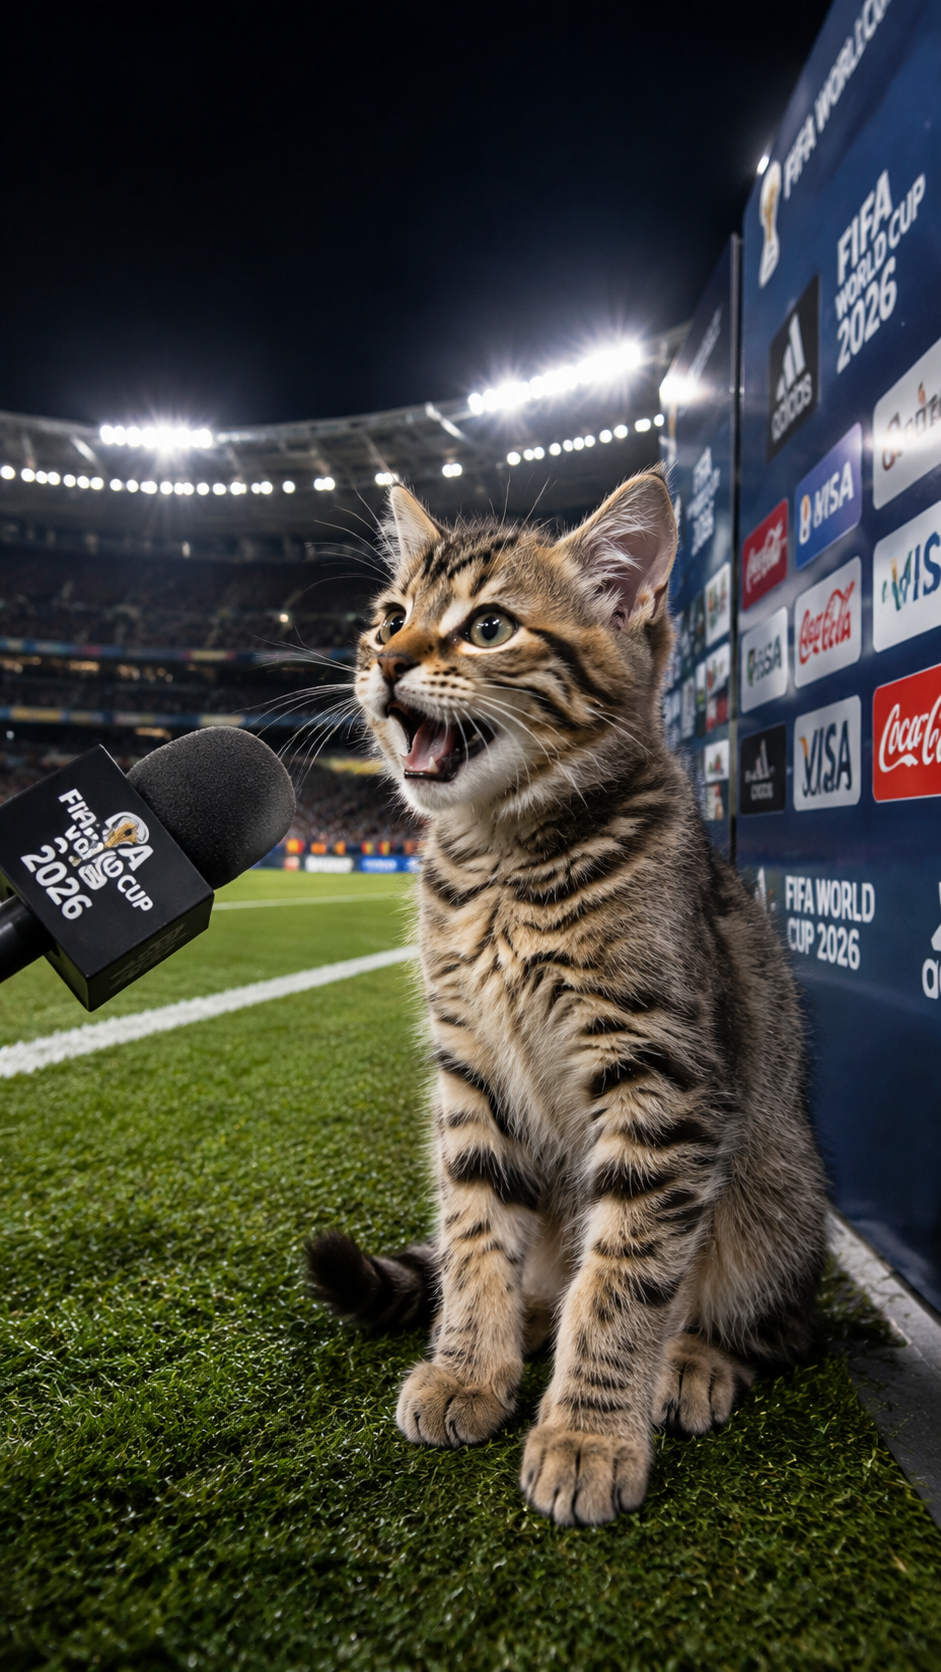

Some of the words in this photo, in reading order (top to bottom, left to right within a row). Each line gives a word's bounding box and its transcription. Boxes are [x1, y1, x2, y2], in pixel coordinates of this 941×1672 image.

[835, 231, 887, 321] WORLD
[888, 173, 926, 250] CUP
[837, 169, 893, 287] FIFA
[837, 256, 897, 374] 2026
[799, 719, 853, 799] VISA
[20, 844, 93, 920] 2026
[117, 874, 154, 912] CUP
[785, 876, 814, 913] FIFA
[814, 878, 876, 924] WORLD
[786, 917, 815, 955] CUP
[816, 922, 860, 971] 2026
